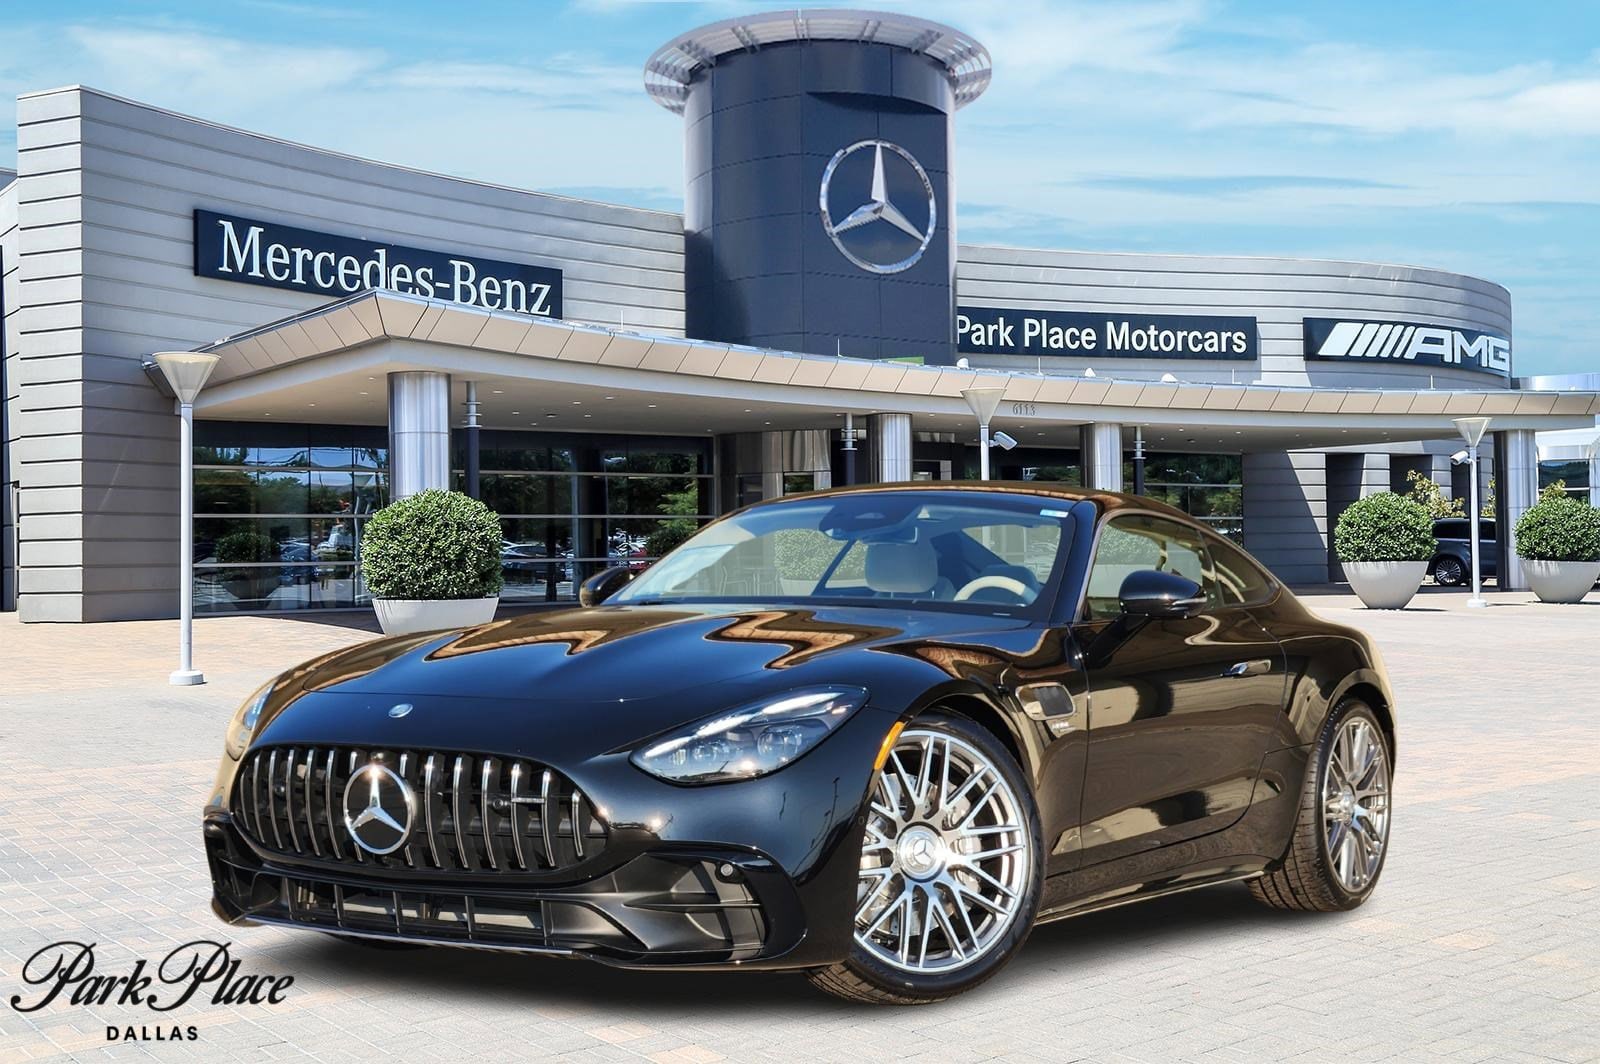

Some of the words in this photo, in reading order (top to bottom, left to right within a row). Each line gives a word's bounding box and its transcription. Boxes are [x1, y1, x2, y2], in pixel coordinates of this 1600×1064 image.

[217, 219, 552, 317] Mercedes-Benz
[957, 315, 1015, 347] Park
[1024, 318, 1097, 350] Place
[1106, 321, 1247, 353] Motorcars
[1404, 326, 1510, 372] AMG
[1012, 402, 1036, 416] 6113
